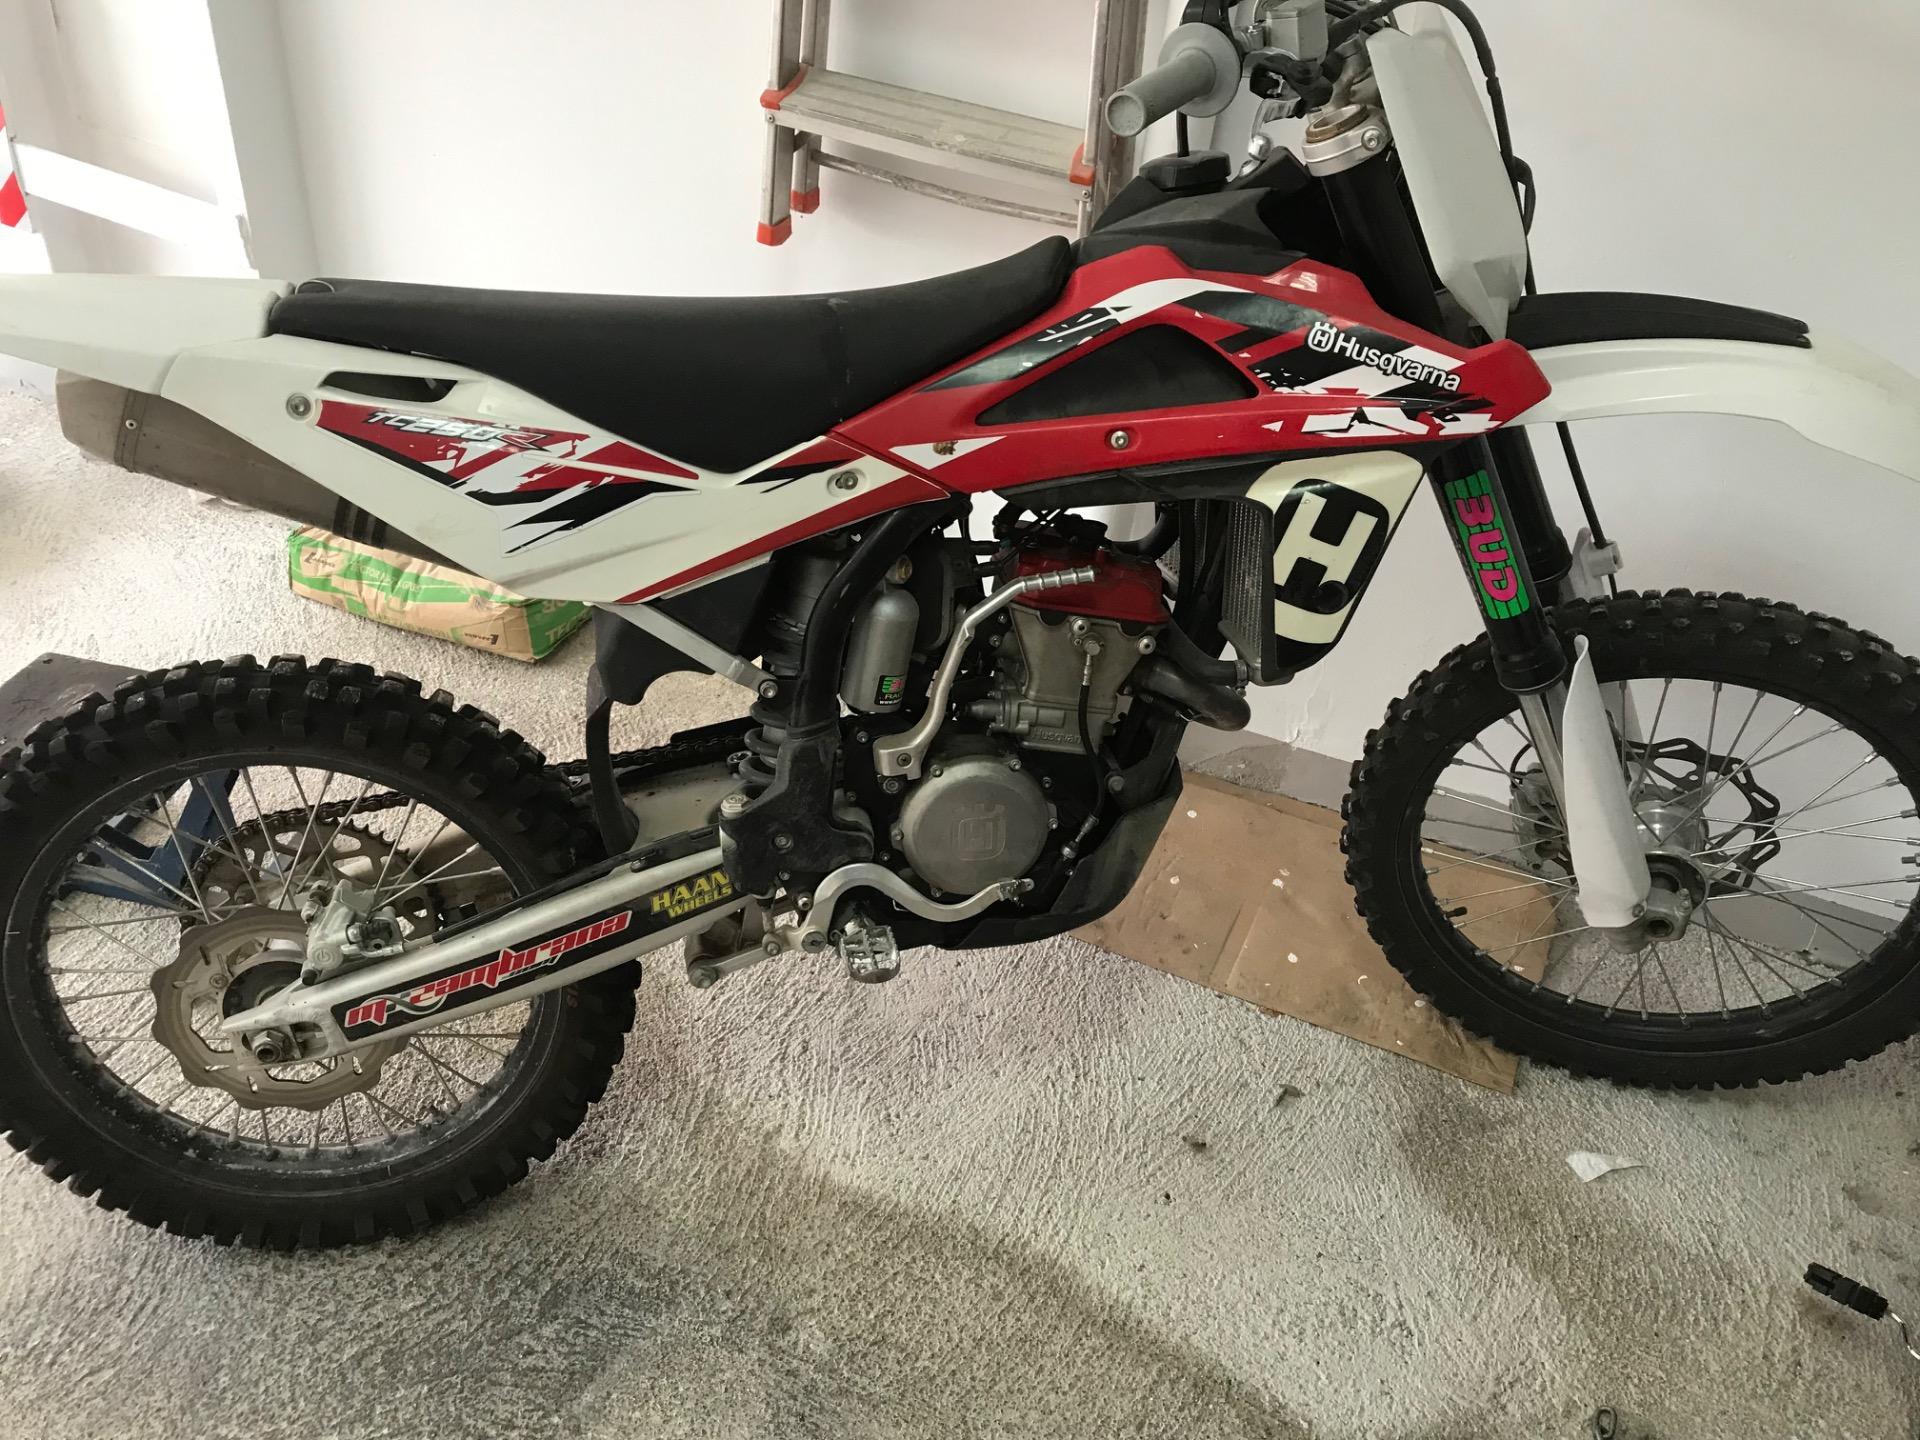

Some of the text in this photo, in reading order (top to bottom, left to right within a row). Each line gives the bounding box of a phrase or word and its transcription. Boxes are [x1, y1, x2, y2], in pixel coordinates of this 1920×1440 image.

[1333, 332, 1461, 392] Husqvarna
[1031, 727, 1084, 746] Husqvar
[651, 870, 729, 914] HAAN
[668, 886, 732, 919] WHEELS
